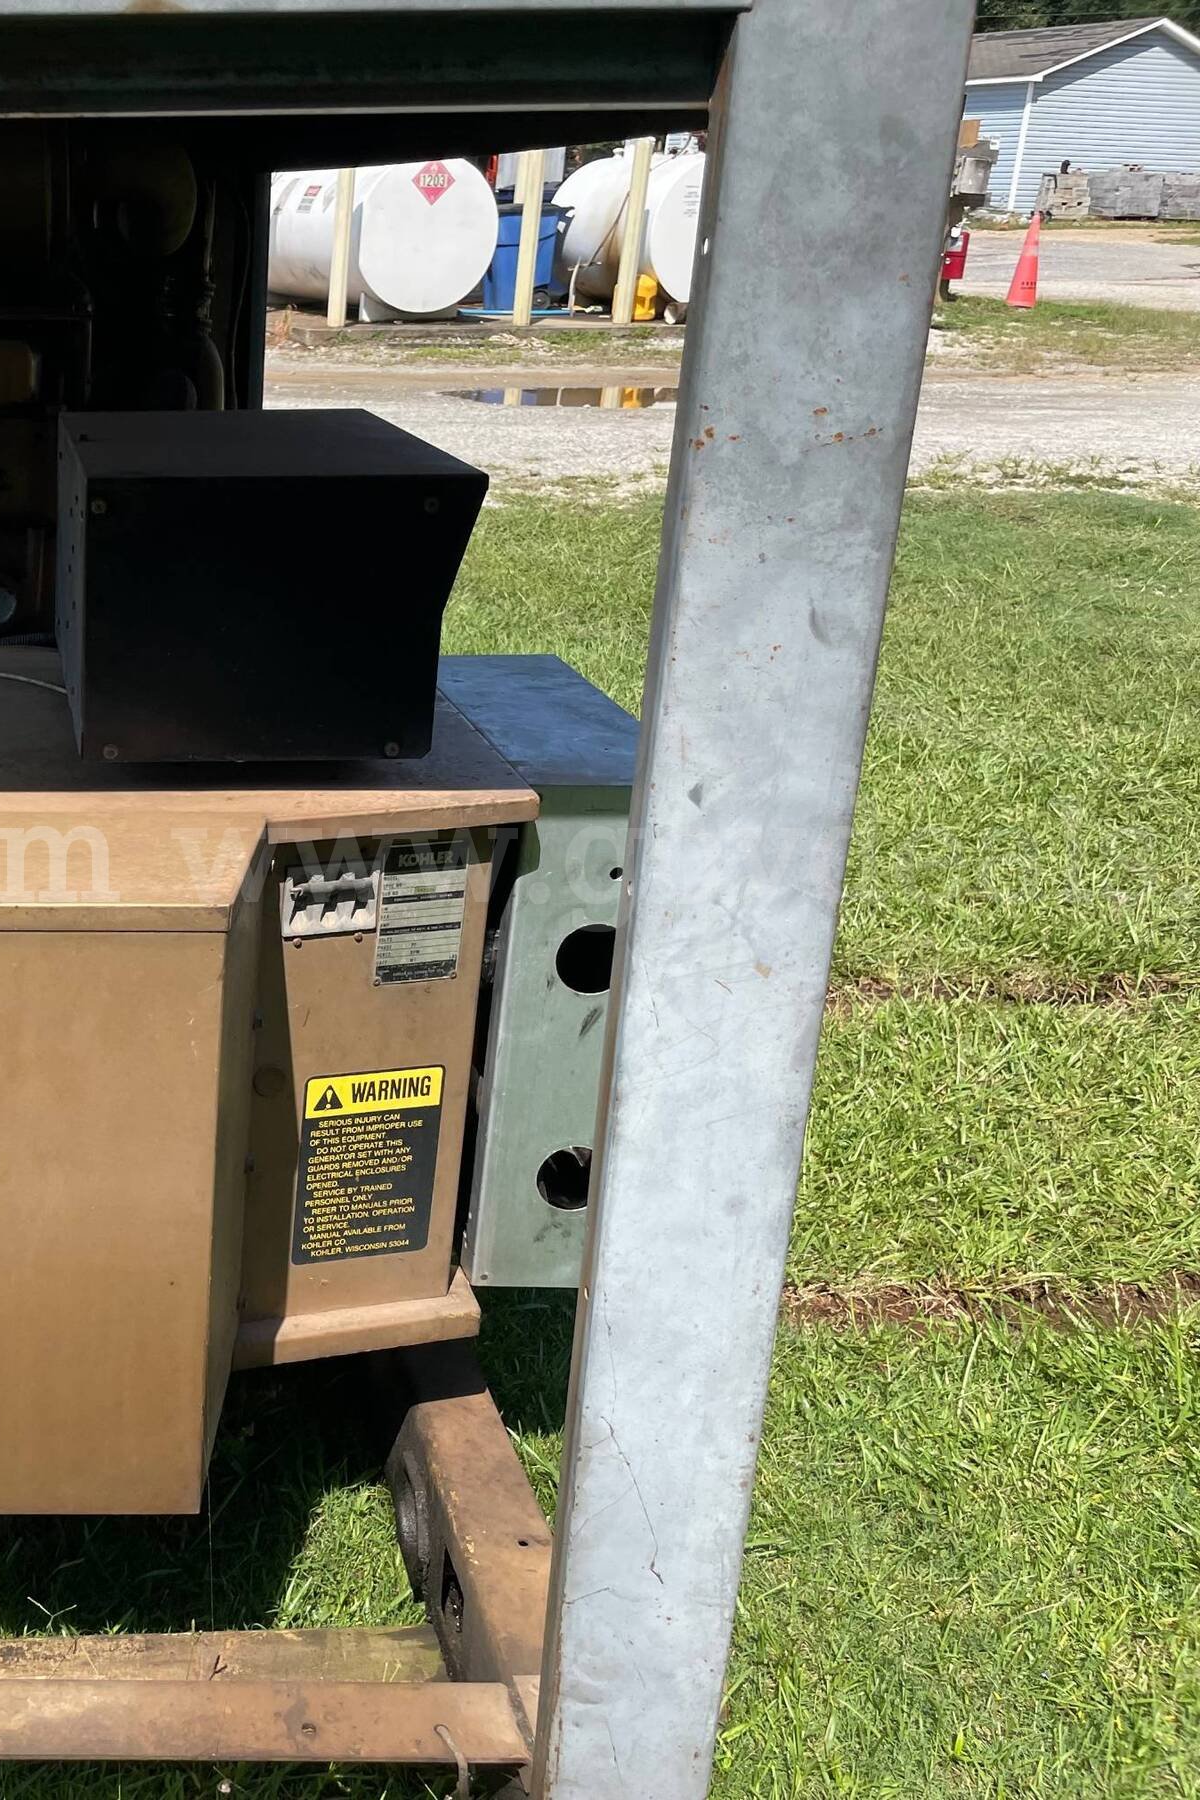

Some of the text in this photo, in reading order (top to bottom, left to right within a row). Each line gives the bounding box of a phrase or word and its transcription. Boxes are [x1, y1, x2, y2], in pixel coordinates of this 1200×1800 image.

[422, 174, 446, 187] 1203
[398, 851, 454, 867] KOHLER
[352, 1075, 432, 1104] WARNING
[311, 1129, 339, 1137] RESULT
[342, 1126, 364, 1134] FROM
[366, 1122, 405, 1131] IMPROPER
[319, 1118, 352, 1128] SERIOUS
[323, 1137, 339, 1145] THIS
[330, 1145, 346, 1153] NOT
[348, 1142, 383, 1151] OPERATE
[309, 1153, 355, 1164] GENERATOR
[308, 1163, 339, 1173] GUARDS
[342, 1159, 380, 1169] REMOVED
[307, 1165, 406, 1181] ELECTRICAL ENCLOSURES
[313, 1188, 345, 1198] SERVICE
[360, 1183, 392, 1192] TRAINED
[305, 1198, 350, 1207] PERSONNEL
[312, 1206, 336, 1215] REFER
[351, 1200, 387, 1210] MANUALS
[372, 1206, 414, 1216] OPERATION
[310, 1223, 406, 1241] MANUAL AVAILABLE FROM
[302, 1240, 332, 1250] KOHLER
[346, 1243, 387, 1252] WISCONSIN
